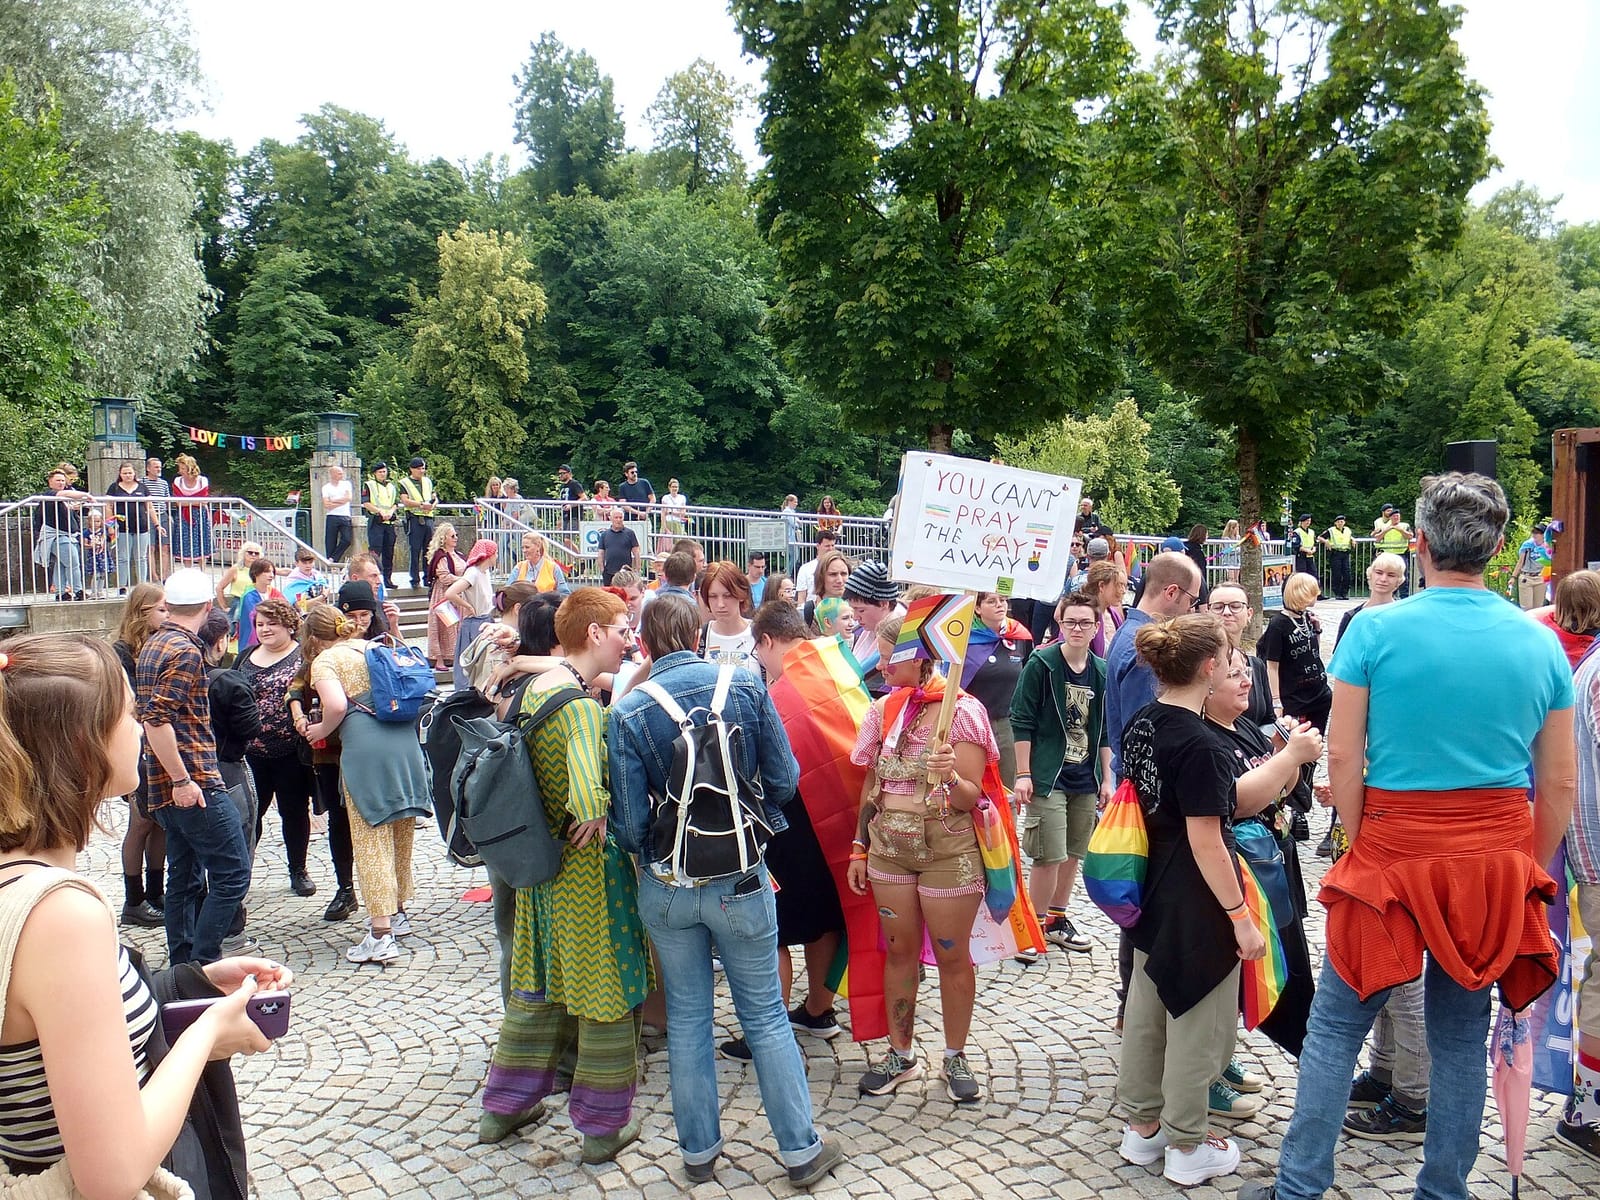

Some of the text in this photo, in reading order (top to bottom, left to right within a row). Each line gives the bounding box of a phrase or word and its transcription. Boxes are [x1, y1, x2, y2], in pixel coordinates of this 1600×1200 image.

[190, 426, 300, 451] LOVE IS LOVE
[938, 469, 985, 500] YOU
[955, 504, 1020, 534] PRAY
[923, 522, 1029, 560] THE GAY
[939, 547, 1021, 574] AWAY
